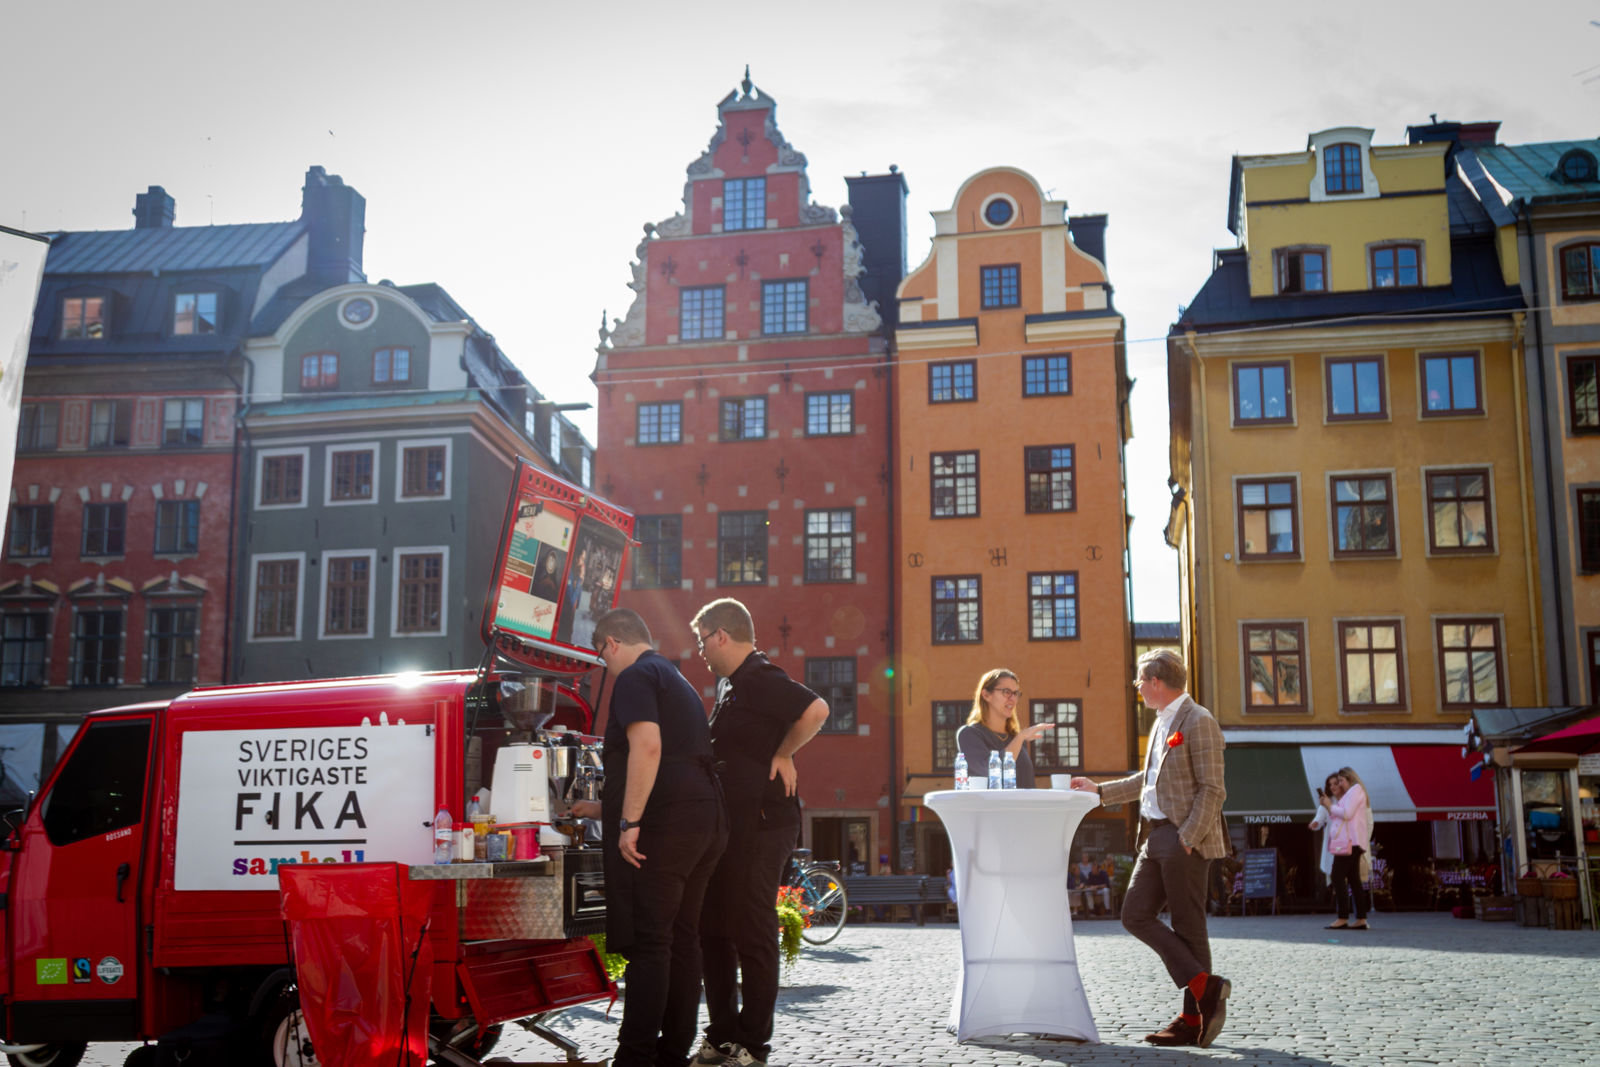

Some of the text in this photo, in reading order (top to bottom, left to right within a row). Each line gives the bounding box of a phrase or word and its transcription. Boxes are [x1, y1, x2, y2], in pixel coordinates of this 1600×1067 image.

[238, 737, 368, 763] SVERIGES
[237, 766, 367, 787] VIKTIGASTE
[235, 790, 367, 830] FIKA
[1244, 815, 1292, 824] TRATTORIA
[1447, 811, 1488, 820] PIZZERIA
